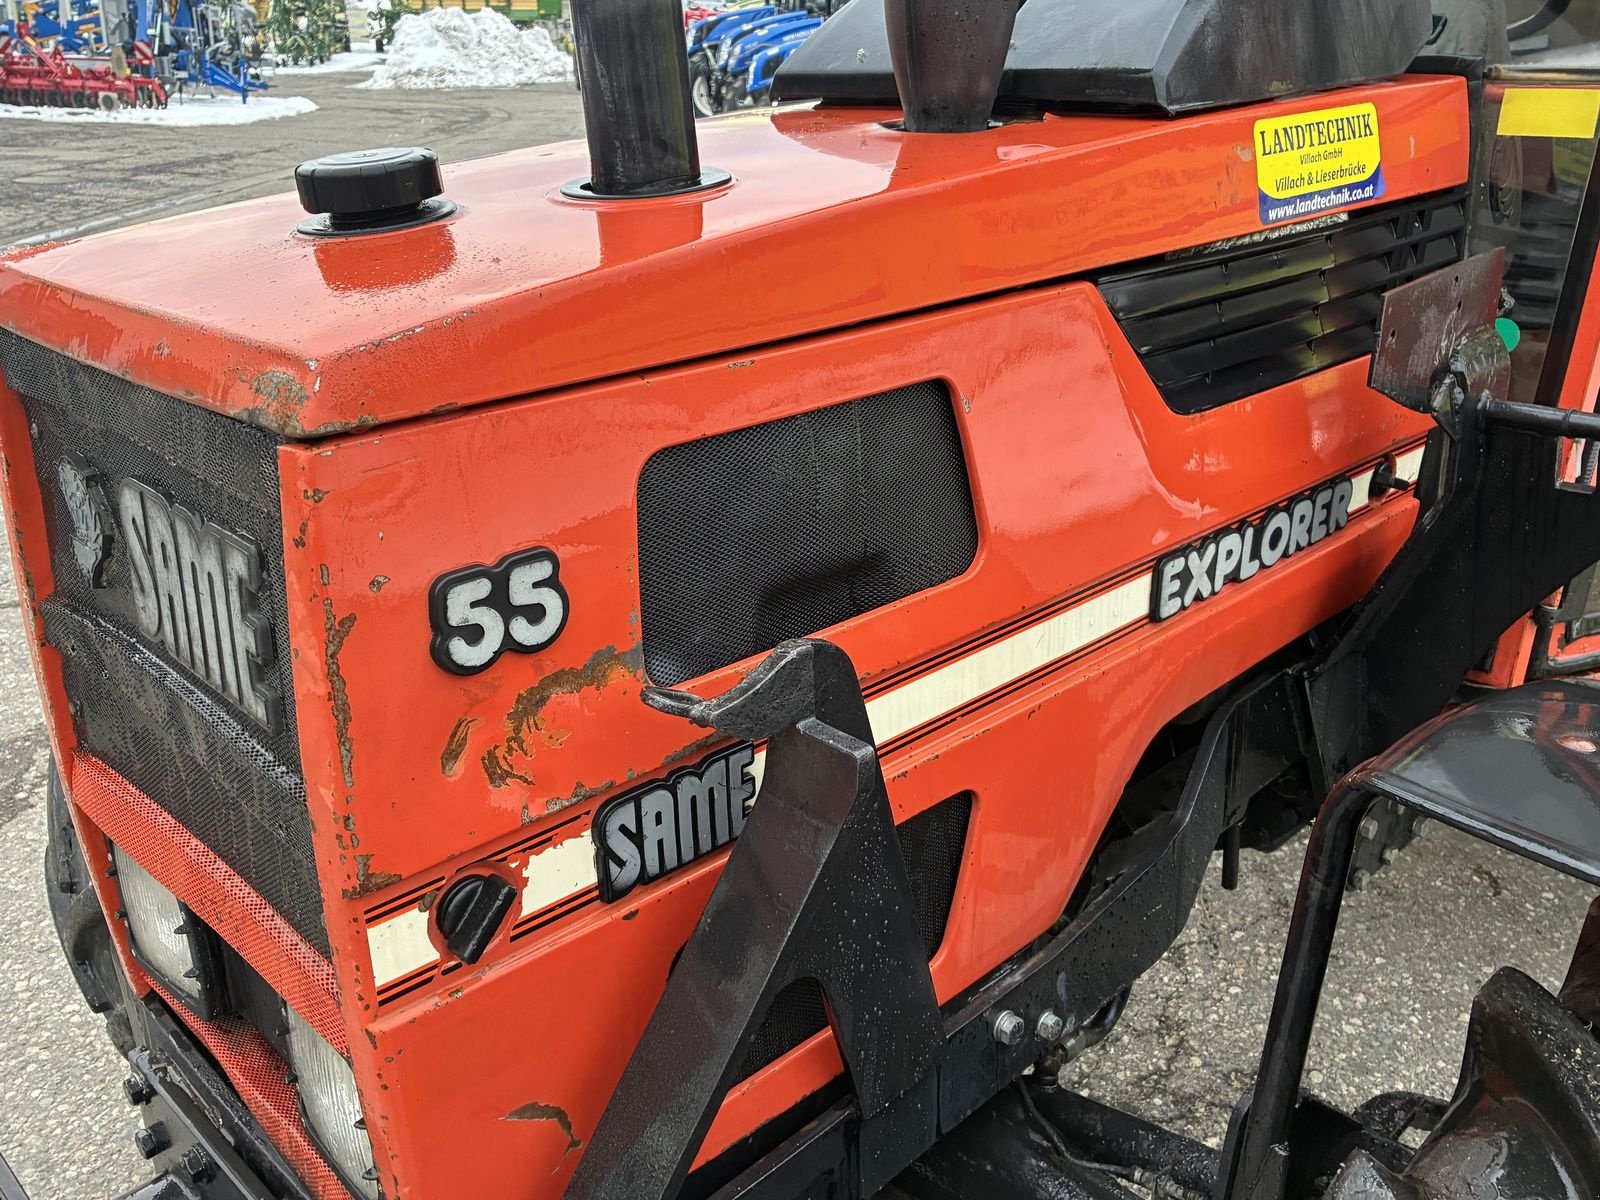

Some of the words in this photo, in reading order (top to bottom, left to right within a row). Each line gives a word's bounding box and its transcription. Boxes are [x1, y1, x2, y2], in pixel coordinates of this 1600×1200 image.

[1259, 113, 1373, 156] LANDTECHNIK
[1299, 151, 1322, 165] Villach
[1323, 147, 1343, 160] GmbH
[1268, 184, 1374, 221] www.landtechnik.co.at
[1275, 173, 1305, 192] Villach
[1307, 173, 1314, 186] &
[1315, 161, 1366, 184] Lieserbrücke
[1159, 479, 1353, 619] EXPLORER
[119, 481, 269, 726] SAME
[446, 559, 564, 668] 55
[604, 745, 757, 890] SAME
